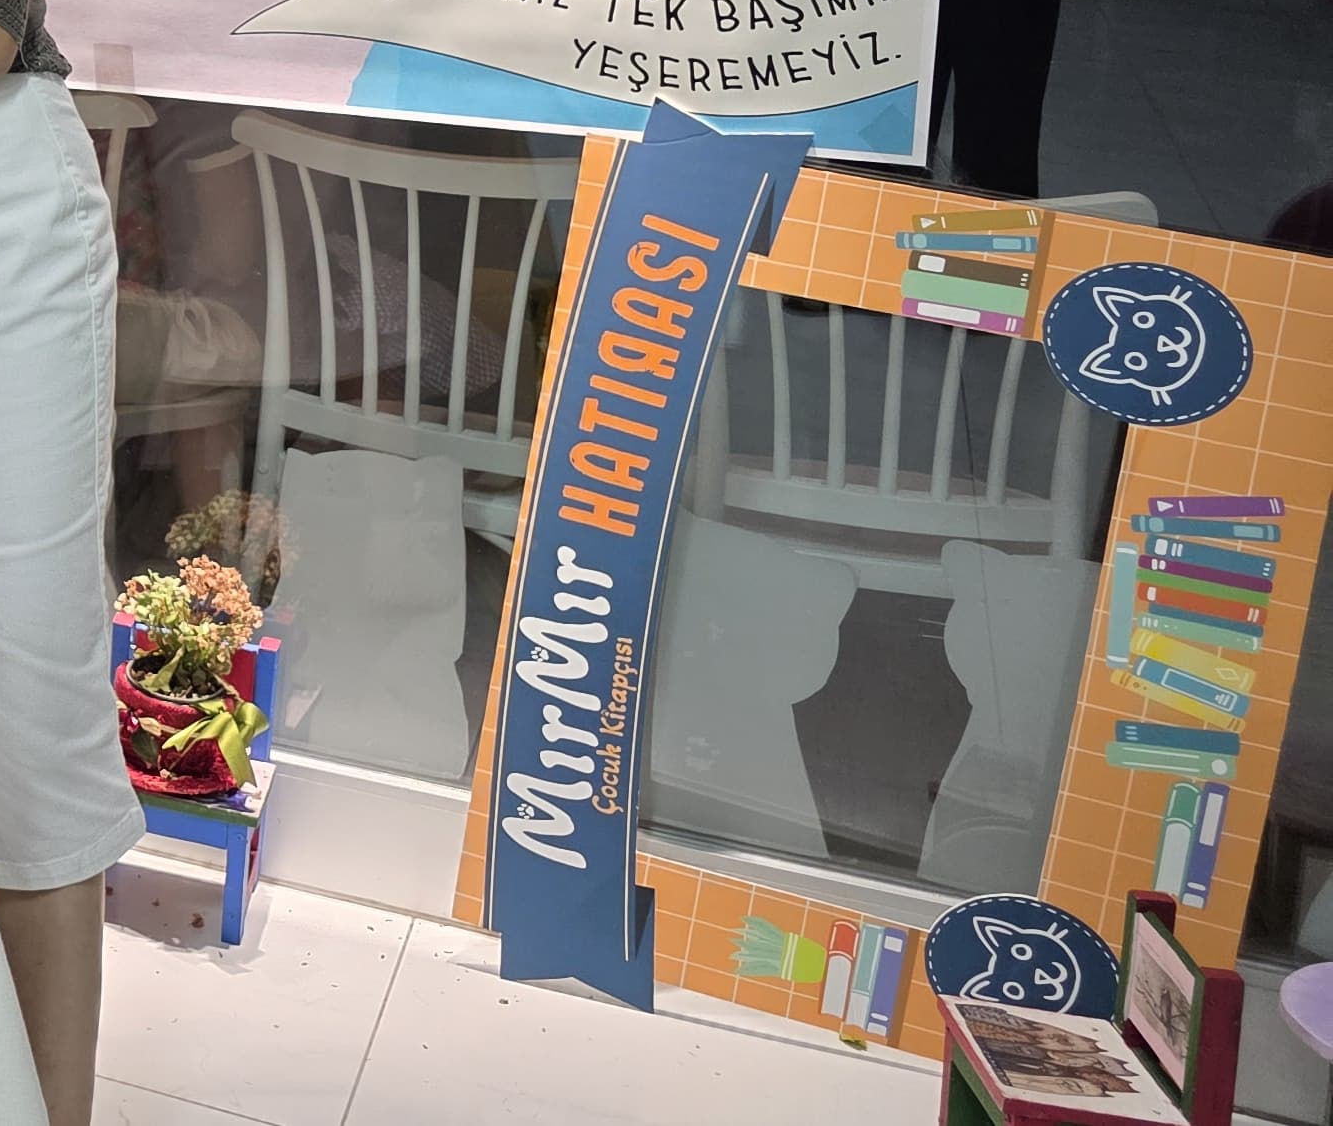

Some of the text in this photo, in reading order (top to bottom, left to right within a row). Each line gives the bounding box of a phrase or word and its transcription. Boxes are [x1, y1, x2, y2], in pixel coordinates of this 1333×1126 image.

[571, 31, 903, 96] YEŞEREMEYİZ.
[558, 212, 720, 539] HATIRASI
[590, 634, 636, 817] Çocuk Kitapçısı
